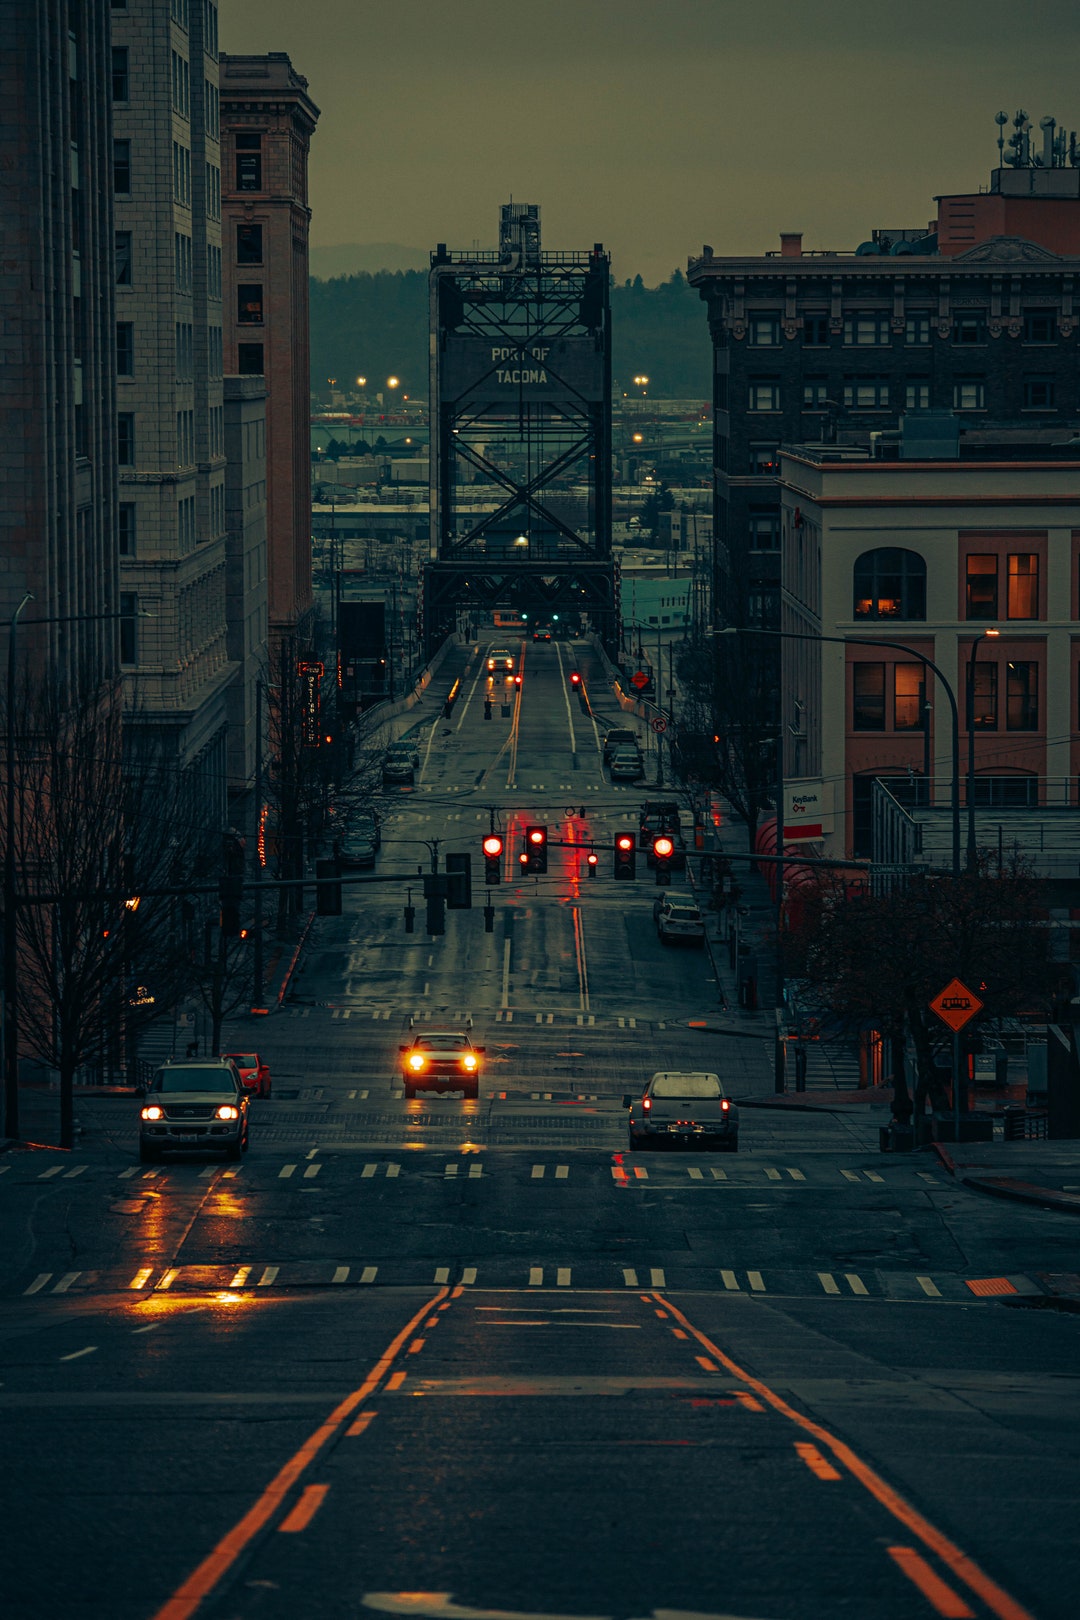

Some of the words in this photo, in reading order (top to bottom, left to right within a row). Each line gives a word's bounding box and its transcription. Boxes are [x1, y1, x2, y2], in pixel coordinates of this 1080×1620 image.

[491, 347, 527, 361] PORT
[532, 347, 550, 361] OF
[495, 369, 548, 384] TACOMA
[792, 794, 818, 804] KeyBank
